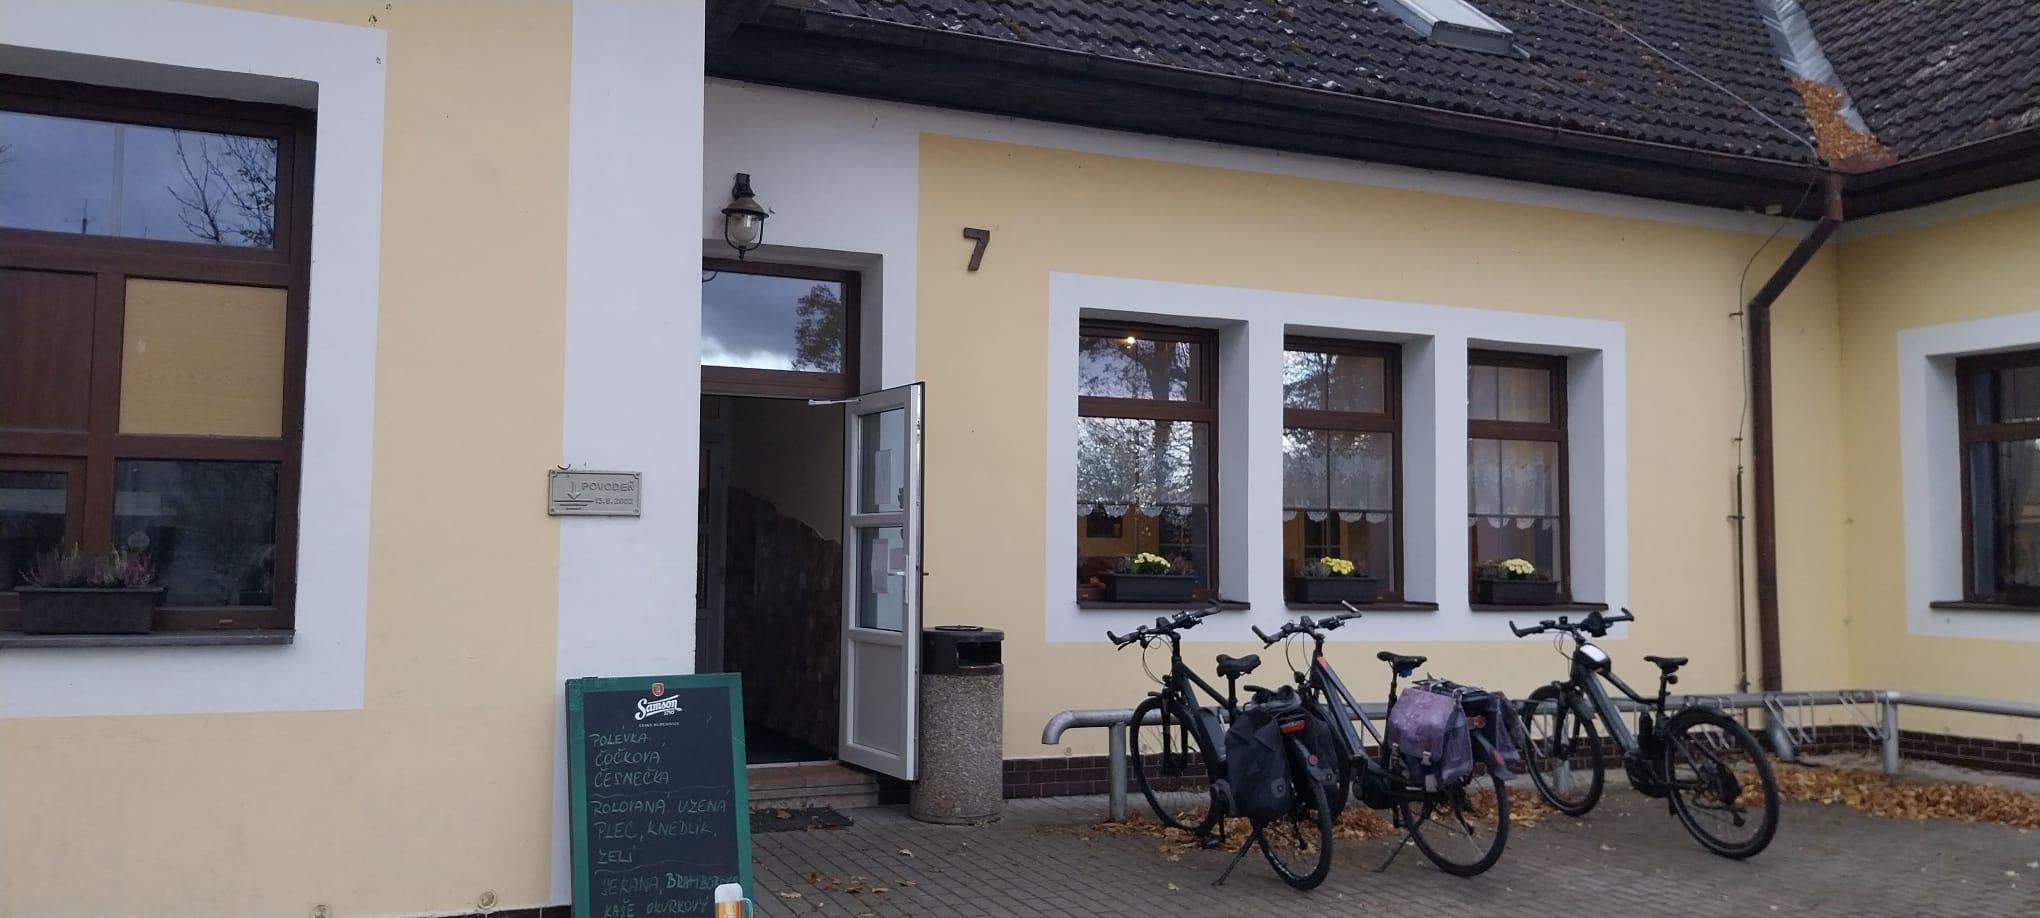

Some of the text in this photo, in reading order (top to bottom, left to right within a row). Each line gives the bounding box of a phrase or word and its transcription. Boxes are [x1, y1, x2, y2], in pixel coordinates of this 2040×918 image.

[963, 227, 991, 271] 7
[582, 480, 634, 492] POVODEŇ
[635, 695, 683, 720] Samson
